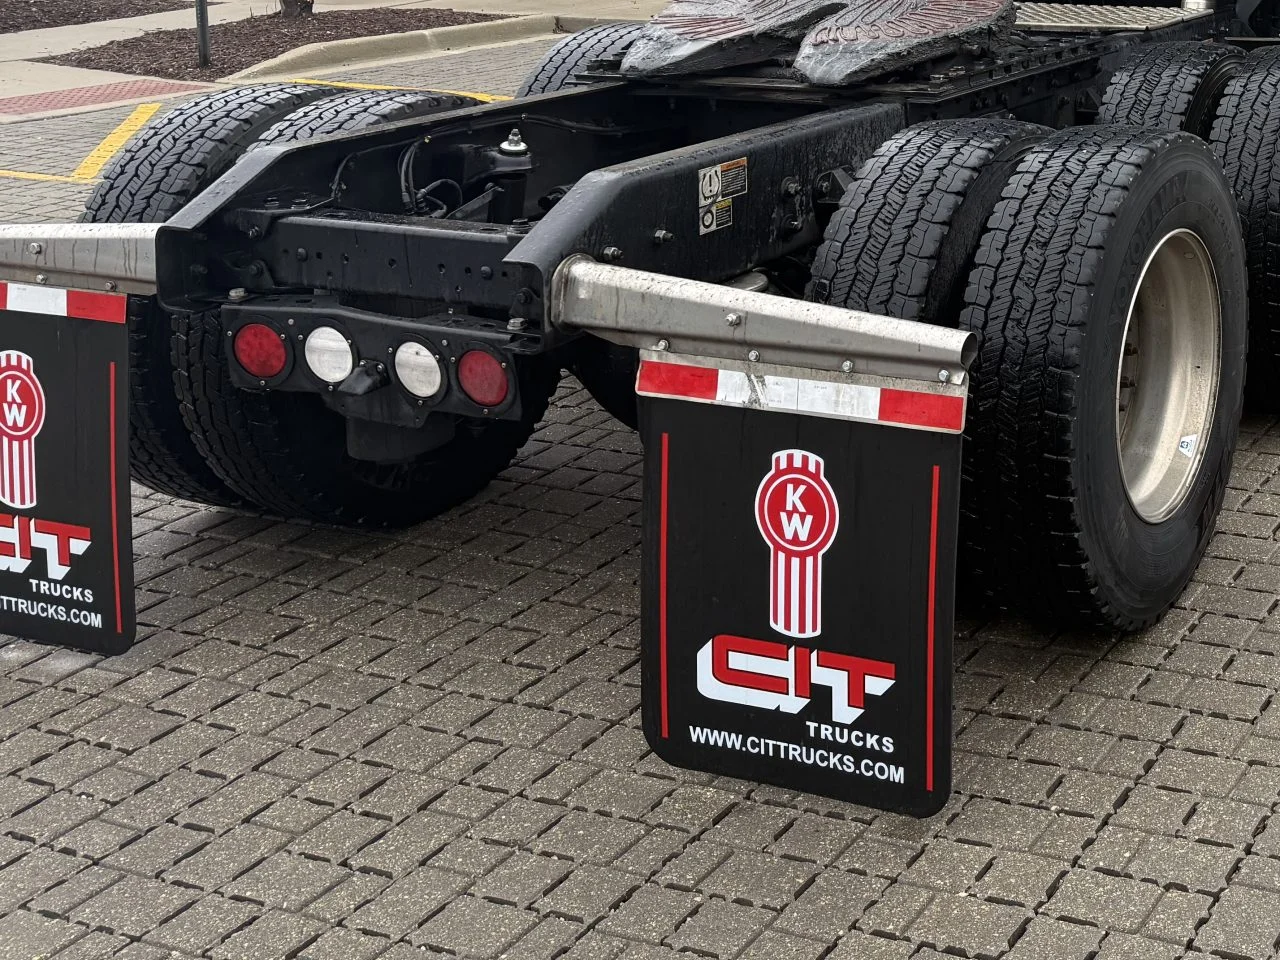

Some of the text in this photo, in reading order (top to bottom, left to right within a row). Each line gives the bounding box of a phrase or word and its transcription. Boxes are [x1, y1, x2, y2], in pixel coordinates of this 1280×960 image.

[29, 578, 94, 603] TRUCKS
[0, 595, 103, 628] TTRUCKS.COM
[697, 634, 897, 723] CIT
[806, 721, 895, 753] TRUCKS
[689, 725, 905, 784] WWW.CITTRUCKS.COM
